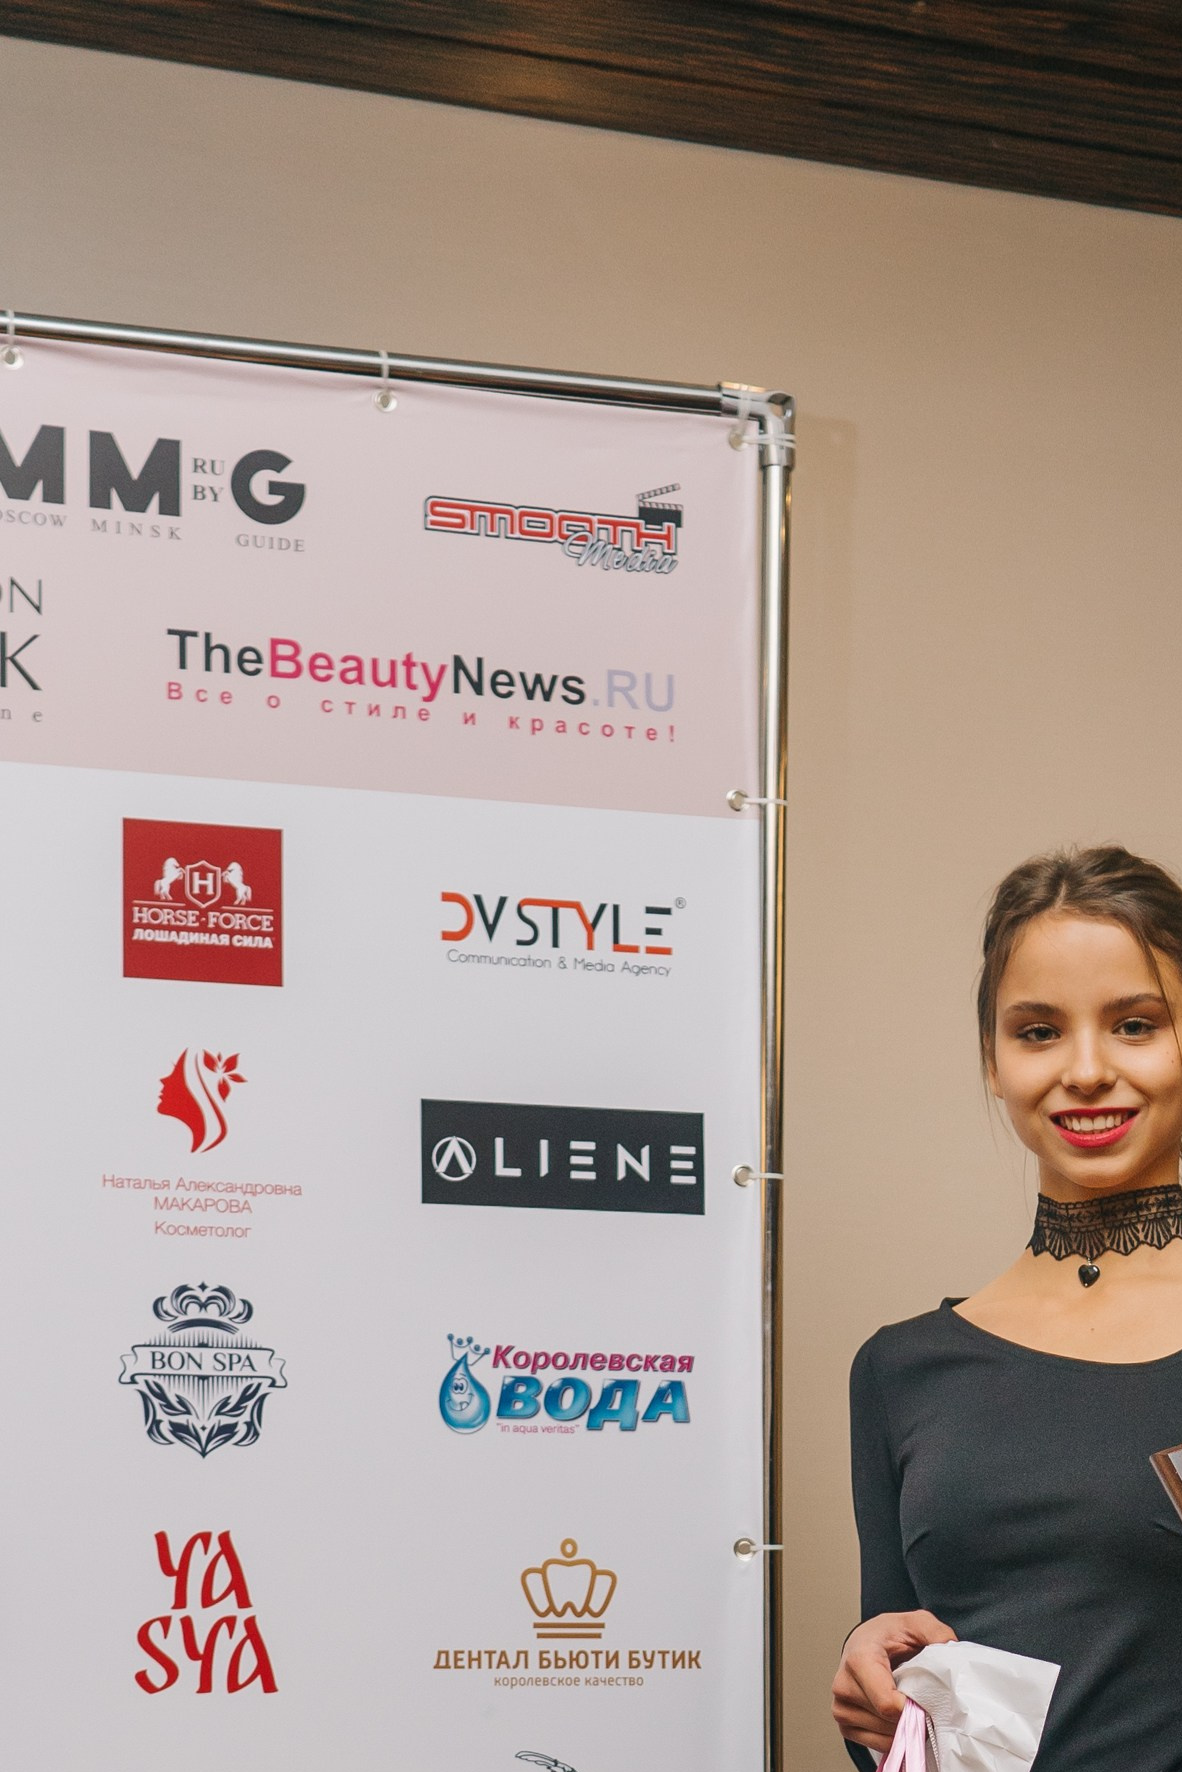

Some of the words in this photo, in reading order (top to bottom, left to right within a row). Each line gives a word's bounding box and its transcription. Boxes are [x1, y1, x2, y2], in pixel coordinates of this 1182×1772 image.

[192, 457, 225, 476] RU
[192, 484, 224, 502] BY
[0, 509, 67, 527] SCOW
[91, 518, 182, 541] MINSK
[235, 533, 305, 553] GUIDE
[425, 495, 677, 554] SMOOTH
[562, 530, 679, 574] Media
[167, 628, 676, 712] TheBeautyNews.RU
[168, 682, 233, 704] Все
[267, 695, 280, 708] о
[322, 699, 430, 721] стиле
[463, 712, 475, 725] и
[509, 714, 675, 742] красоте!
[132, 928, 230, 945] ЛОШАДИНАЯ
[232, 935, 273, 948] СИЛА
[447, 949, 552, 969] Communication
[557, 956, 568, 970] &
[573, 958, 615, 973] Media
[621, 960, 672, 977] Agency
[432, 1136, 696, 1184] ALIENE
[102, 1174, 171, 1192] Наталья
[175, 1175, 303, 1197] Александровна
[154, 1197, 252, 1214] МАКАРОВА
[154, 1221, 252, 1239] Косметолог
[150, 1350, 204, 1371] BON
[213, 1352, 258, 1373] SPA
[491, 1345, 695, 1374] Королевская
[496, 1375, 690, 1431] ВОДА
[512, 1424, 538, 1434] aqua
[154, 1530, 253, 1610] YA
[134, 1615, 279, 1695] SYA
[433, 1650, 529, 1670] ДЕНТАЛ
[538, 1650, 620, 1669] БЬЮТИ
[628, 1650, 702, 1669] БУТИК
[494, 1676, 581, 1689] королевское
[584, 1676, 644, 1687] качество
